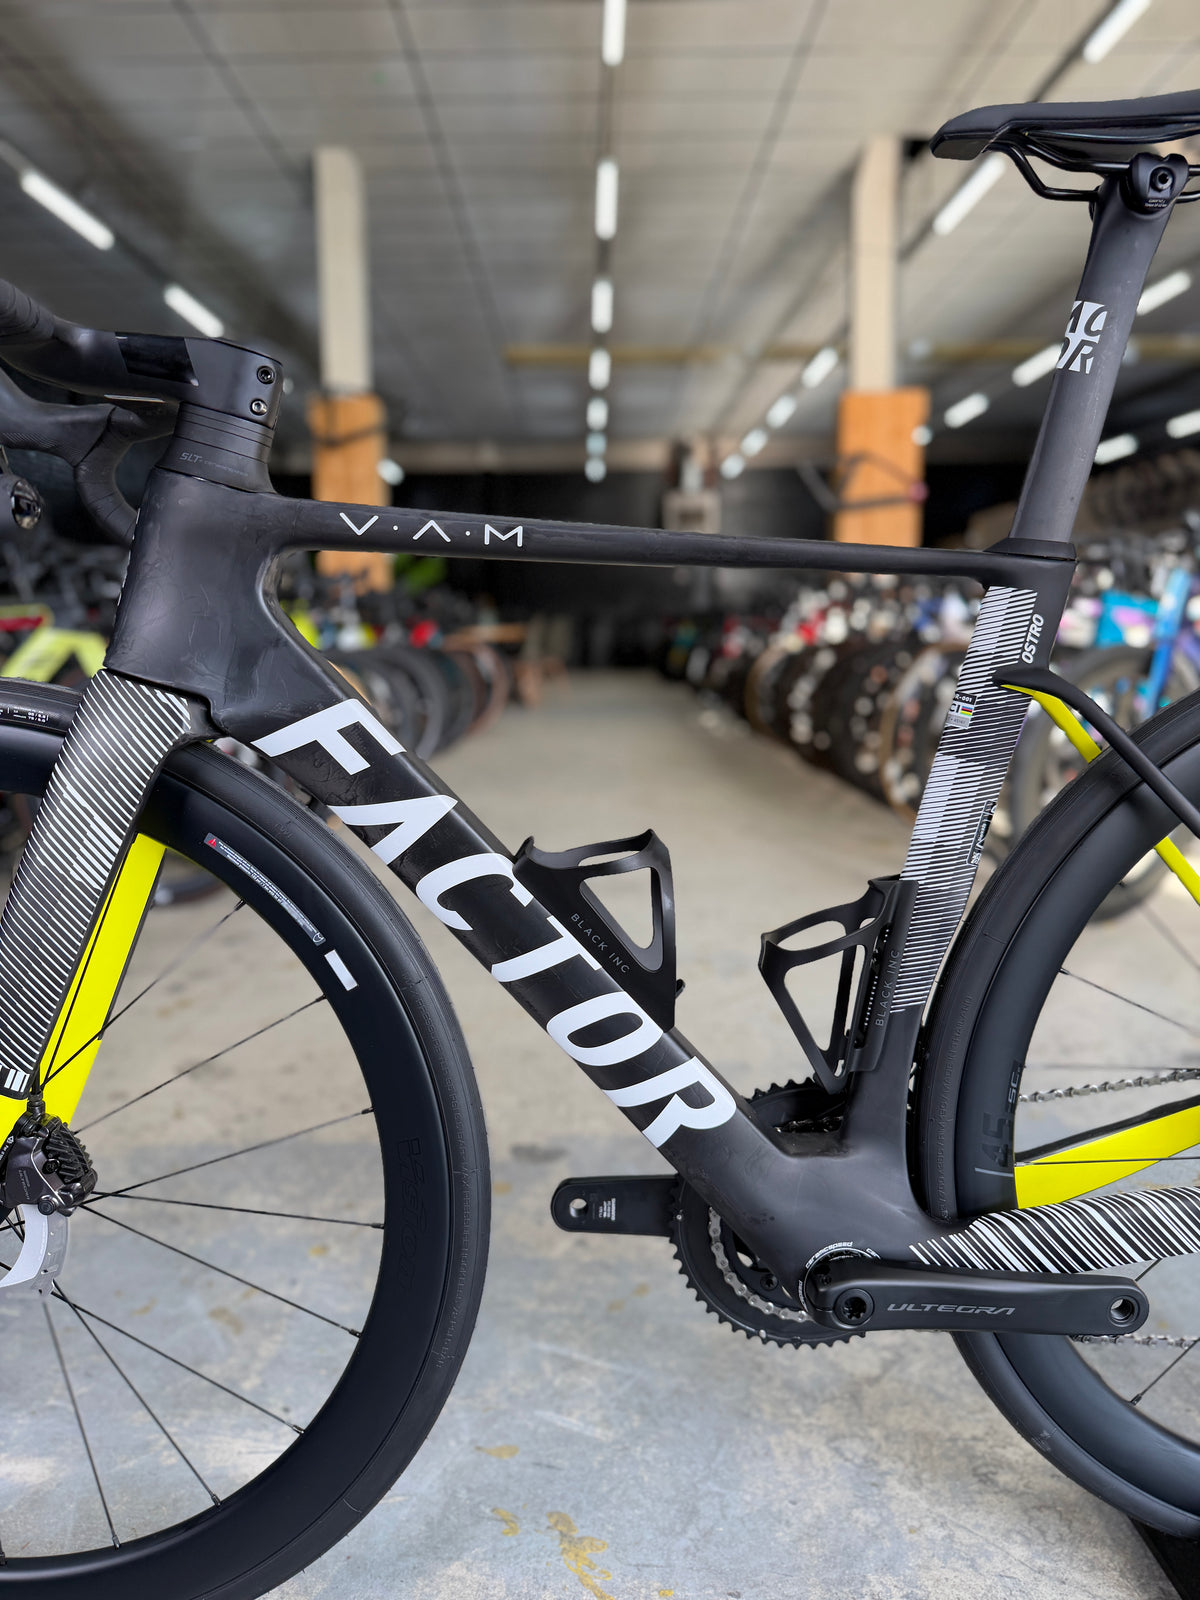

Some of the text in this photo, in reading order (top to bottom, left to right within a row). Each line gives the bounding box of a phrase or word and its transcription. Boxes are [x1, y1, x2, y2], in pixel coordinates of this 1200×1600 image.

[1021, 613, 1044, 664] OSTRO
[252, 698, 738, 1148] FACTOR
[571, 913, 630, 973] BLACK INC
[875, 950, 900, 1026] BLACK INC
[886, 1302, 1017, 1316] ULTEGRA
